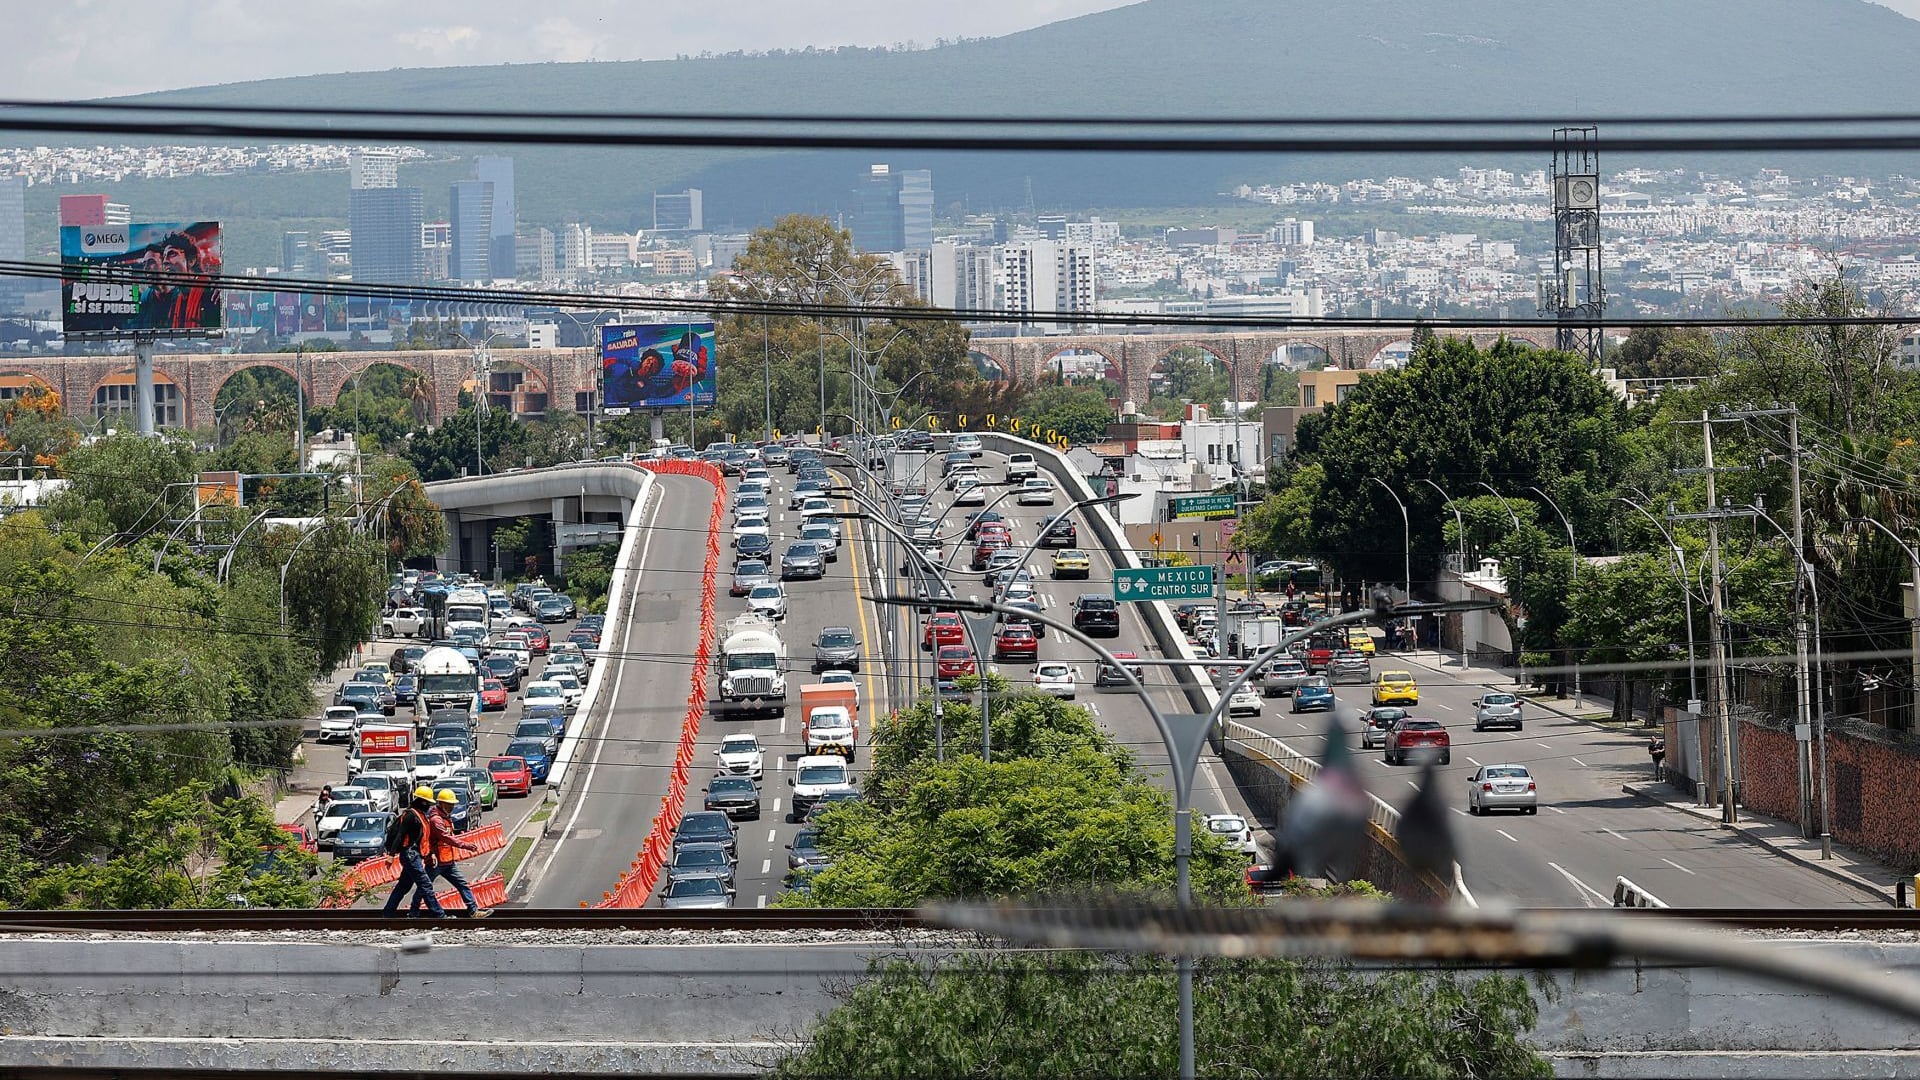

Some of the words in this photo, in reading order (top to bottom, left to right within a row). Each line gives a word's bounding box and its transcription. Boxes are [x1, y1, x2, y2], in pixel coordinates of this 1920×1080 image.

[96, 233, 124, 244] MEGA
[72, 282, 139, 302] PUEDE!
[88, 303, 102, 314] SE
[103, 303, 140, 314] PUEDE!
[607, 337, 638, 351] SALVADA
[1158, 571, 1205, 582] MEXICO
[1151, 585, 1187, 596] CENTRO
[1191, 584, 1209, 594] SUR
